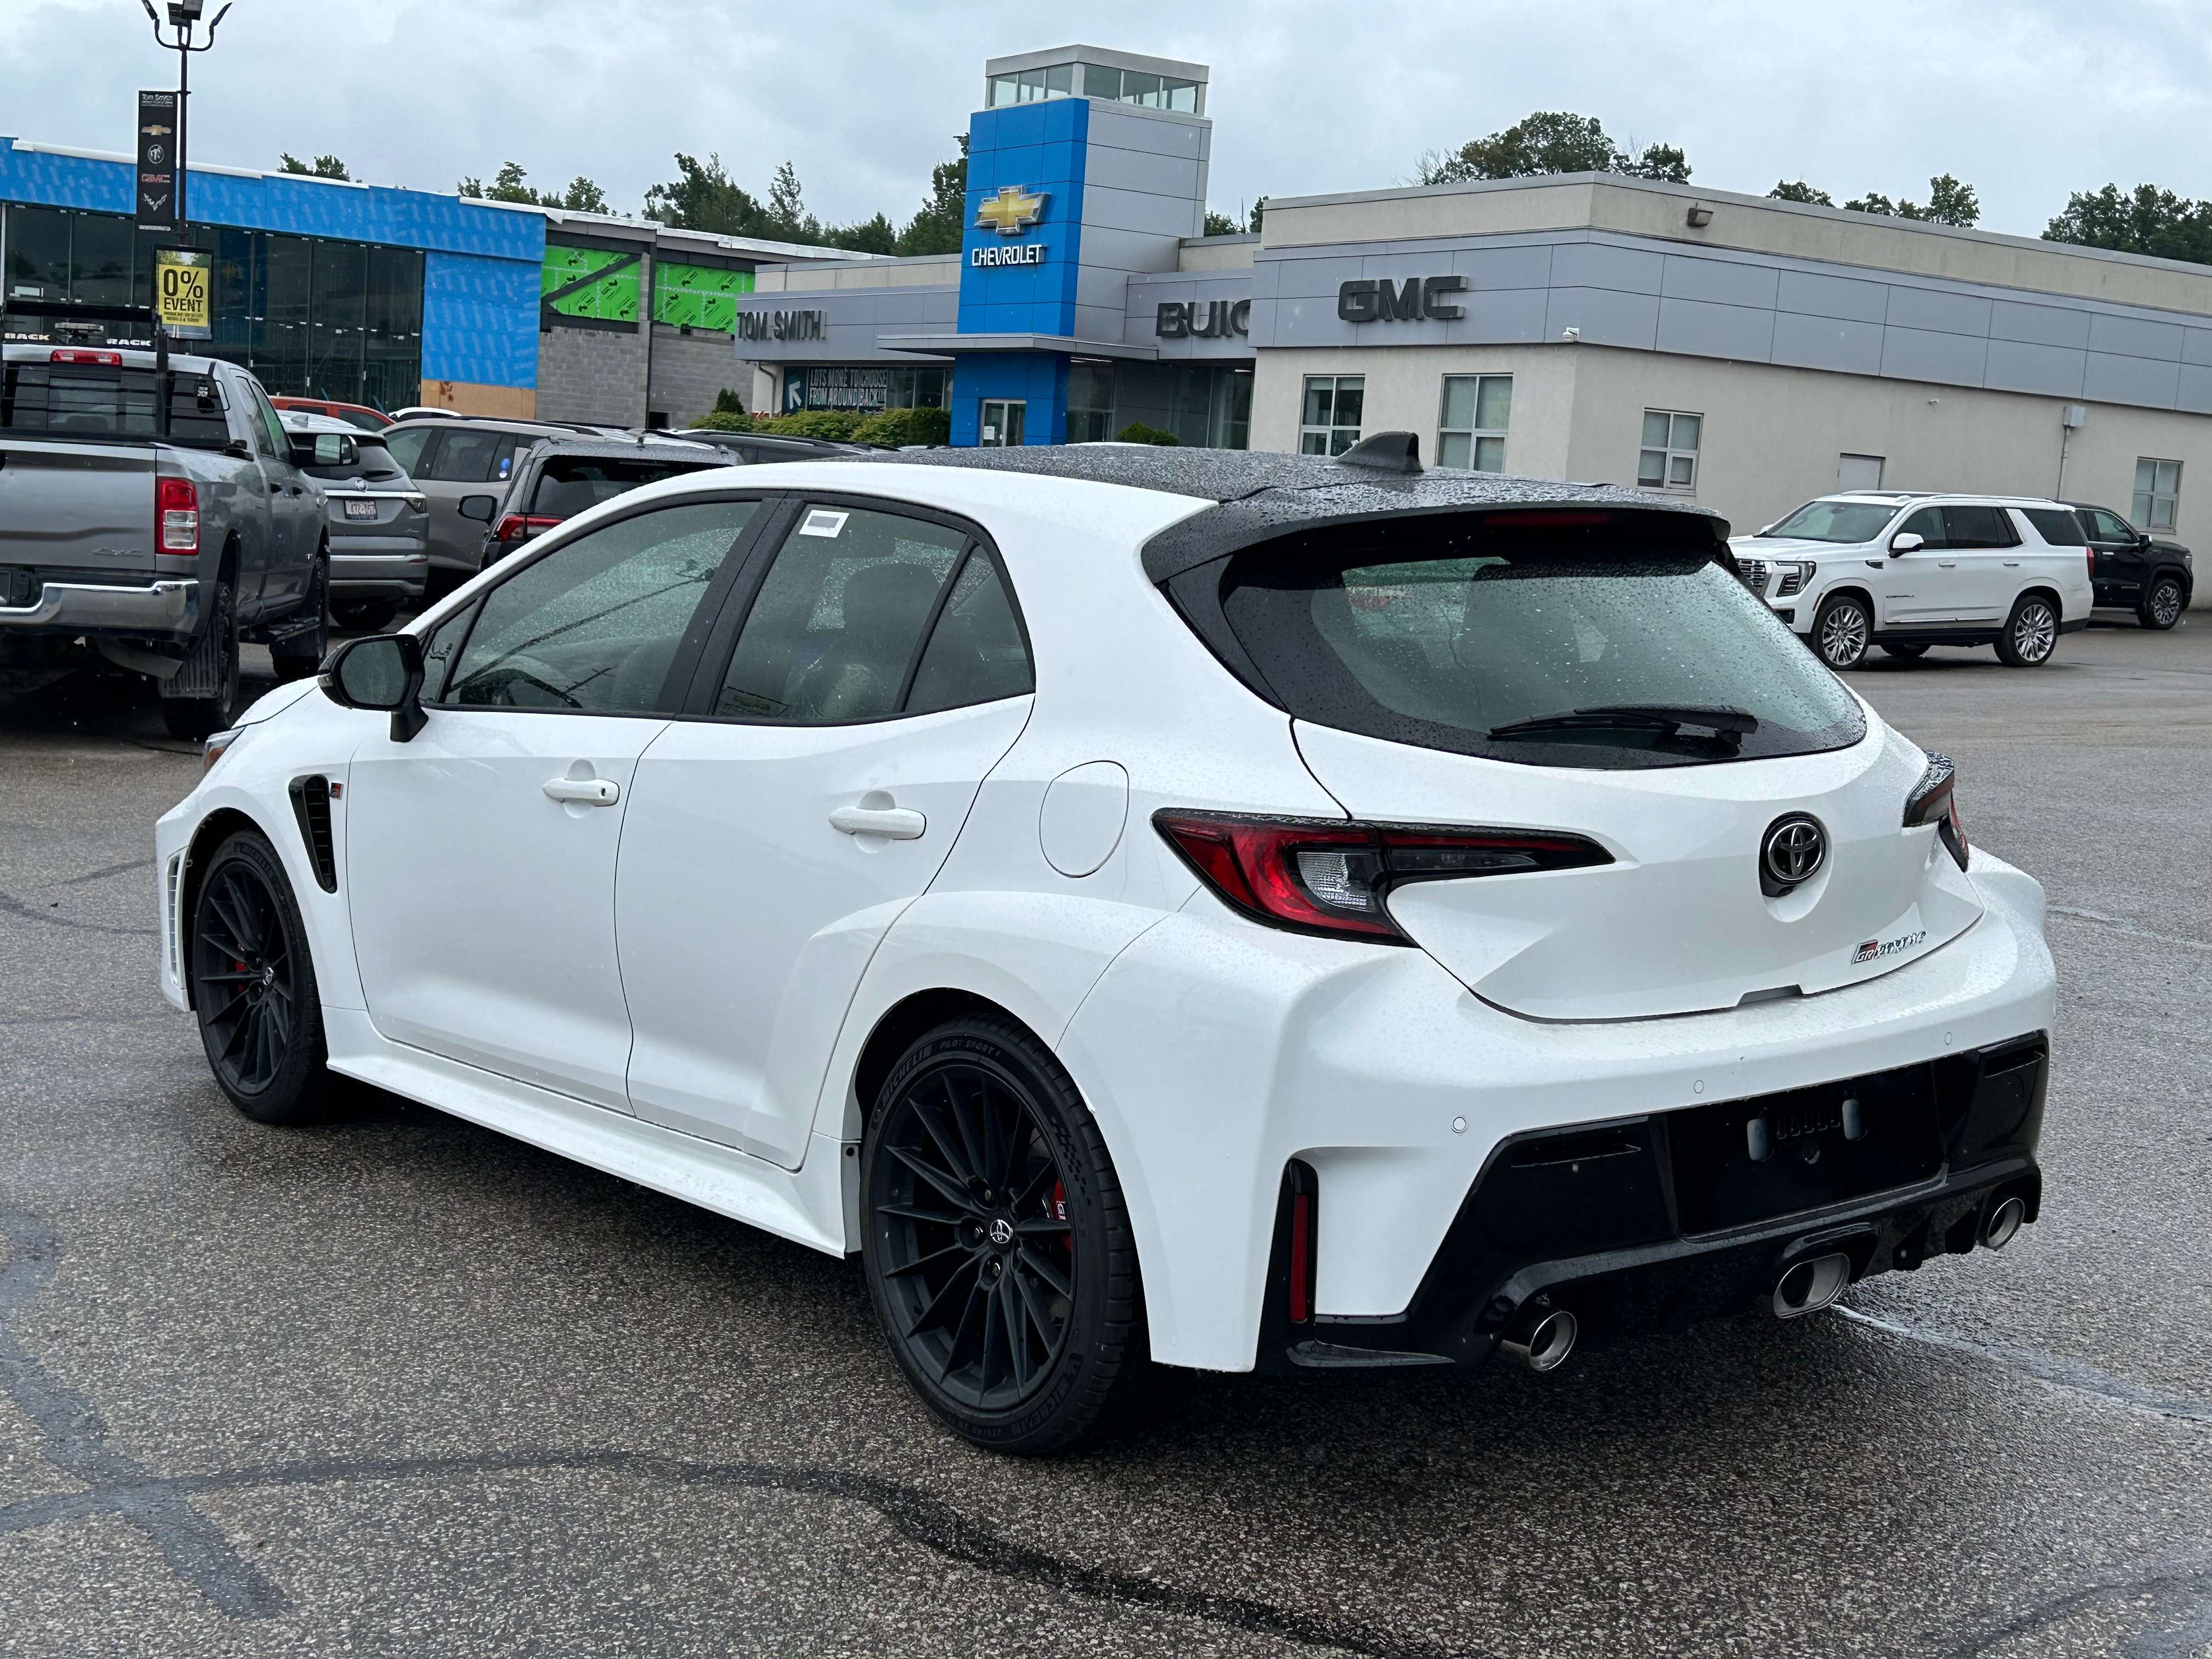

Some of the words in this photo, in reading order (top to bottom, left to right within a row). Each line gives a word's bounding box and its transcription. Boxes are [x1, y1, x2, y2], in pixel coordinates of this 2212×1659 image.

[972, 244, 1042, 266] CHEVROLET
[163, 269, 204, 298] 0%
[1338, 275, 1468, 321] GMC
[163, 297, 203, 312] EVENT
[1156, 300, 1251, 337] BUIC
[4, 332, 50, 341] BACK
[106, 338, 151, 347] RACK
[737, 311, 769, 340] TOM
[774, 310, 826, 340] SMITH
[940, 1040, 965, 1049] PILOT
[966, 1040, 995, 1054] SPORT
[882, 1043, 932, 1108] MICHELIN
